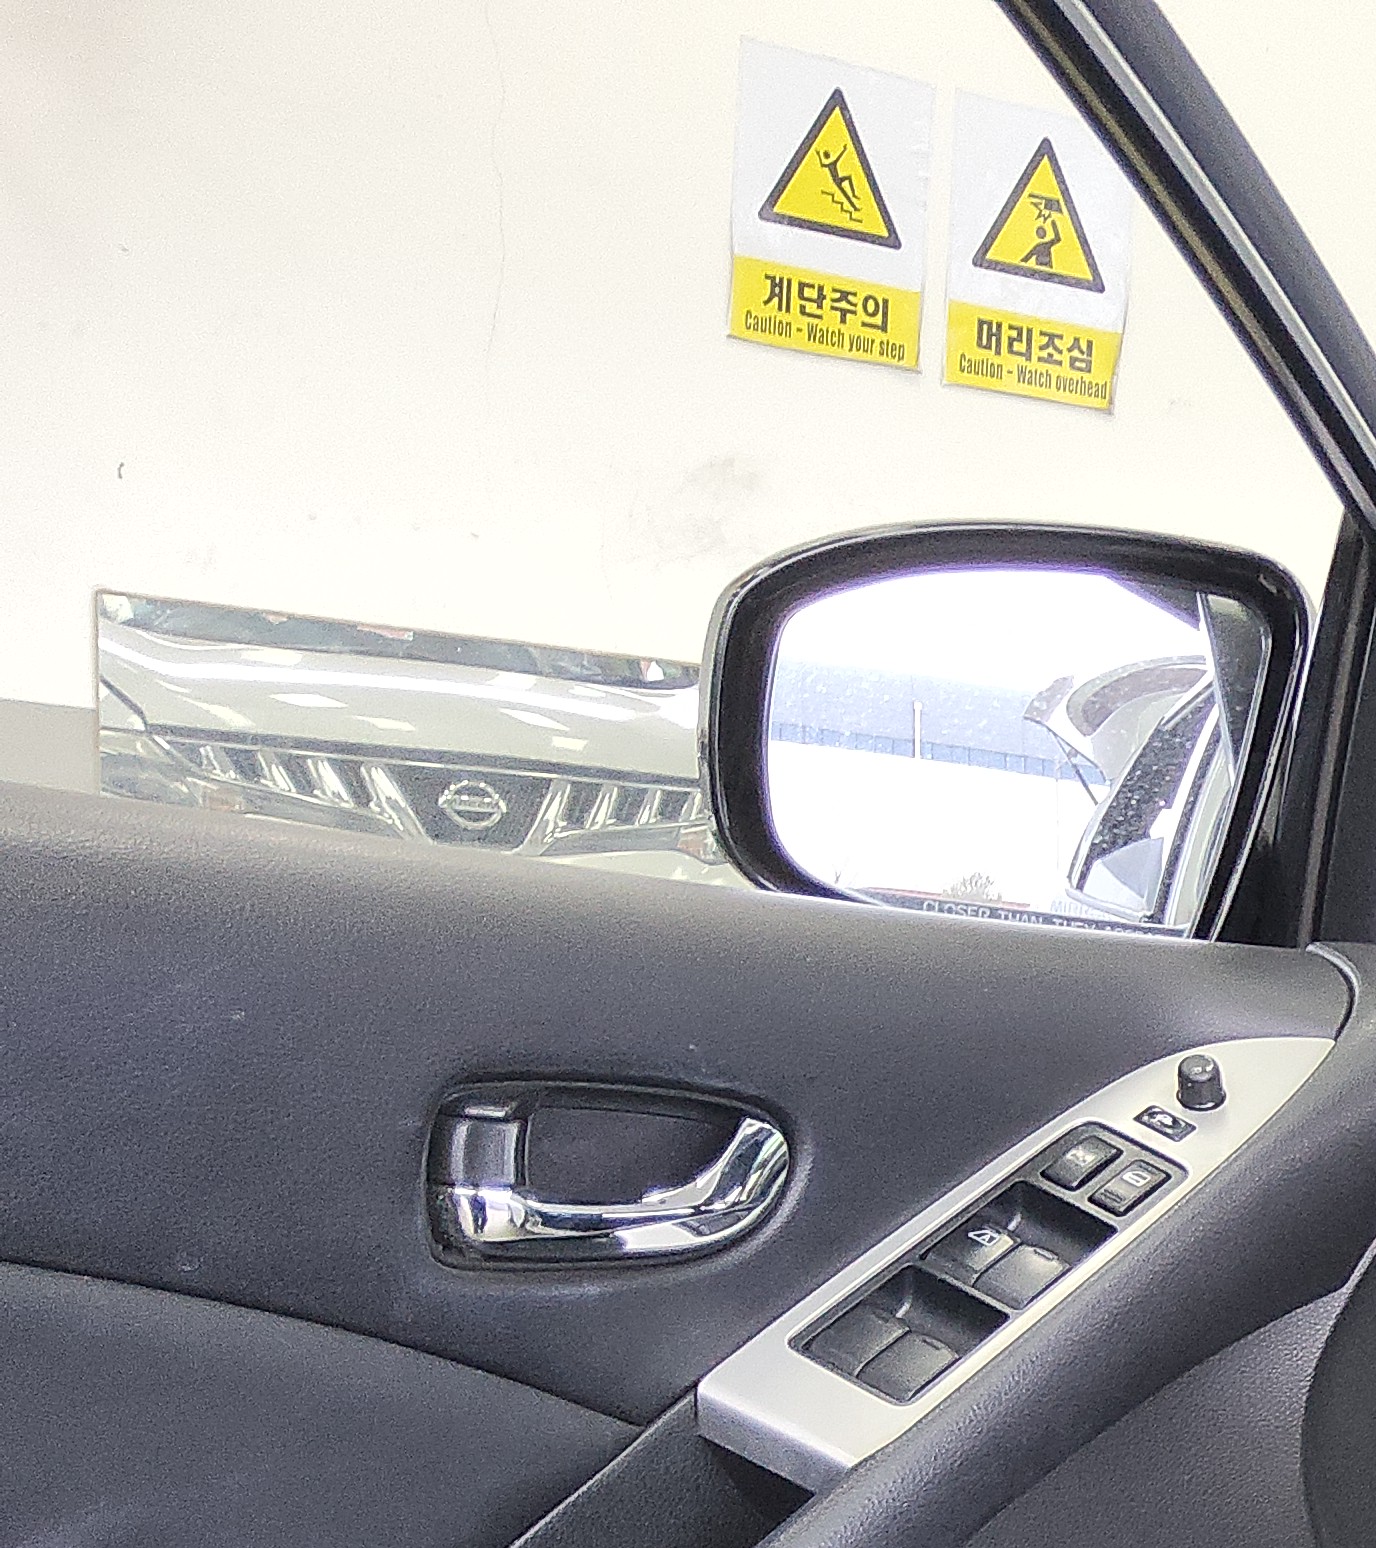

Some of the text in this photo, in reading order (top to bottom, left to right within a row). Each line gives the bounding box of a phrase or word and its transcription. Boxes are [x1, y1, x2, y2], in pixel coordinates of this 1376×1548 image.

[763, 273, 889, 333] 계단주의
[745, 310, 792, 338] Caution
[807, 323, 844, 349] Watch
[849, 333, 875, 356] your
[879, 339, 905, 362] step
[976, 318, 1093, 373] 머리조심
[960, 352, 1003, 379] Caution
[1017, 364, 1051, 389] Watch
[1056, 374, 1107, 399] overhead
